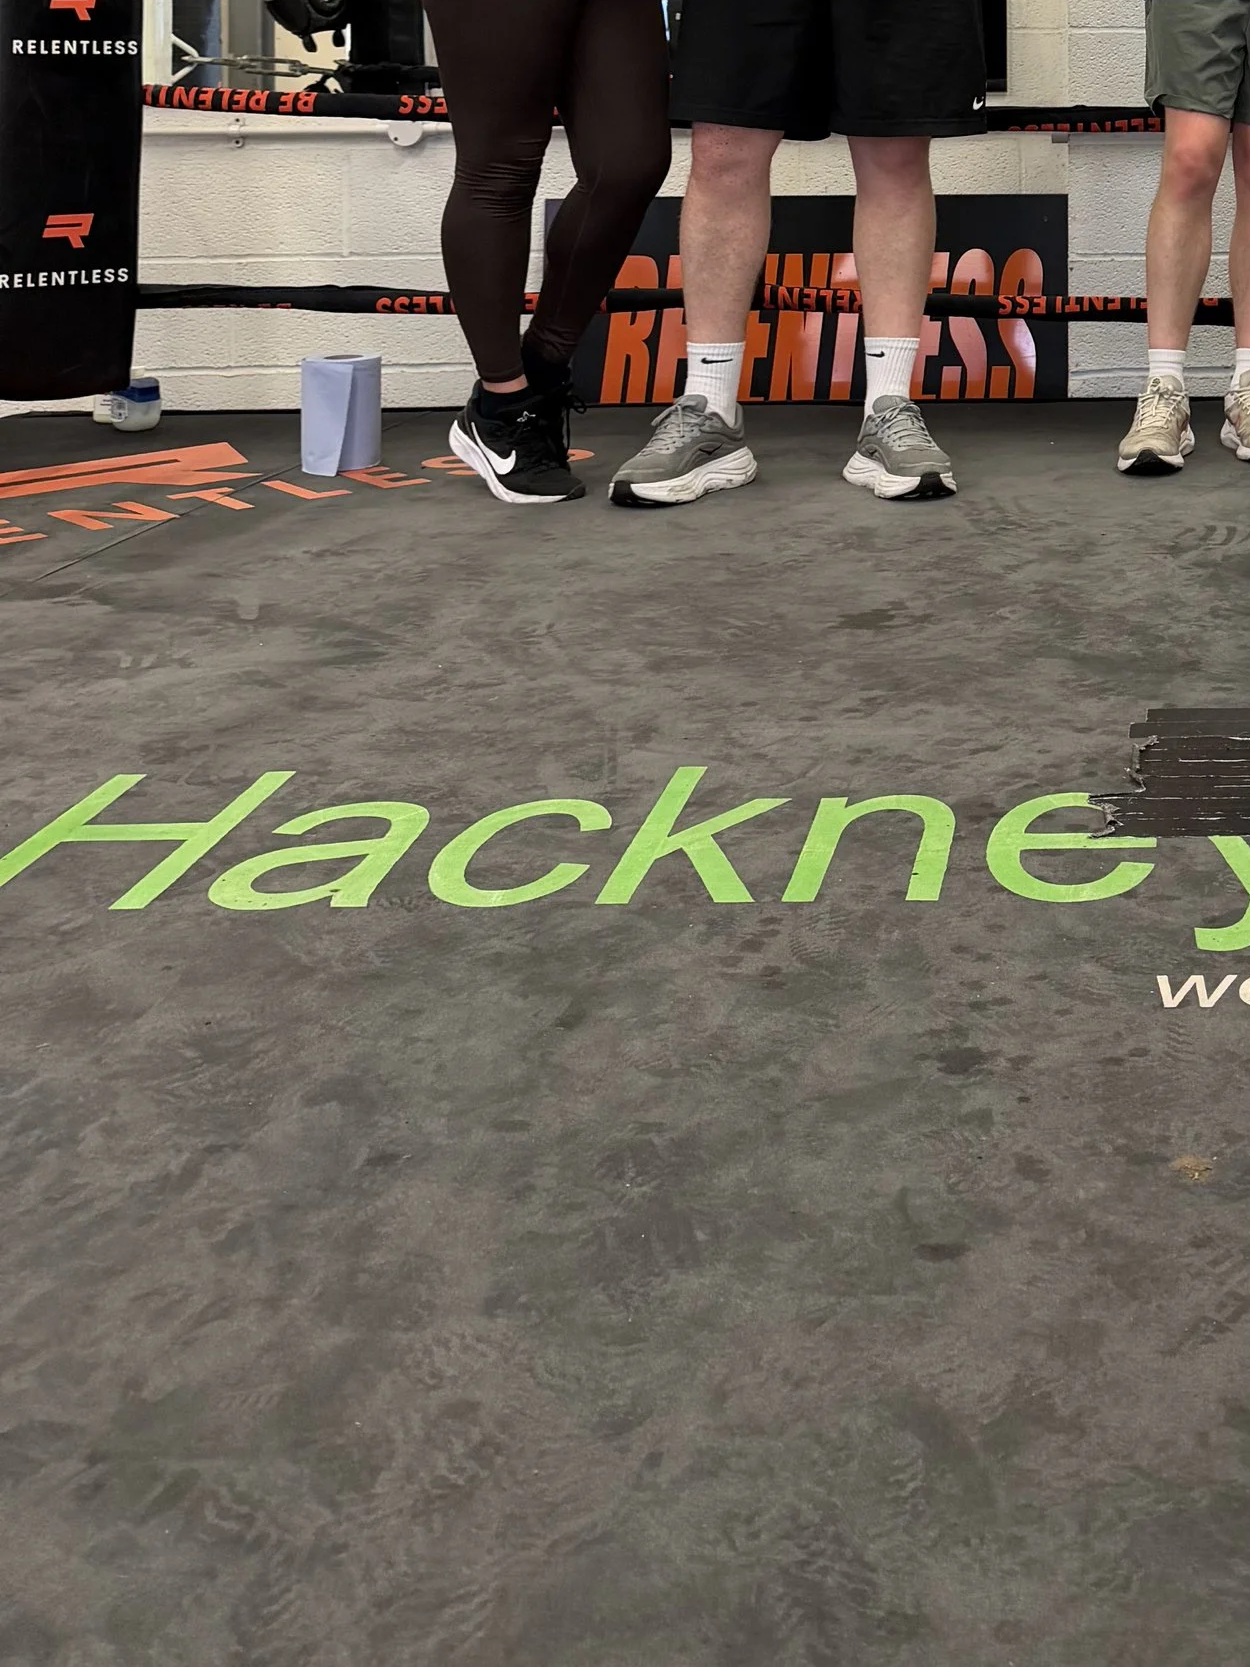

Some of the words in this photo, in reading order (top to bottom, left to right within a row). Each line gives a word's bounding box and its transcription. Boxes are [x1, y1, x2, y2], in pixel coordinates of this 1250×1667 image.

[12, 39, 138, 55] RELENTLESS
[278, 92, 318, 112] BE
[0, 267, 129, 289] RELENTLESS
